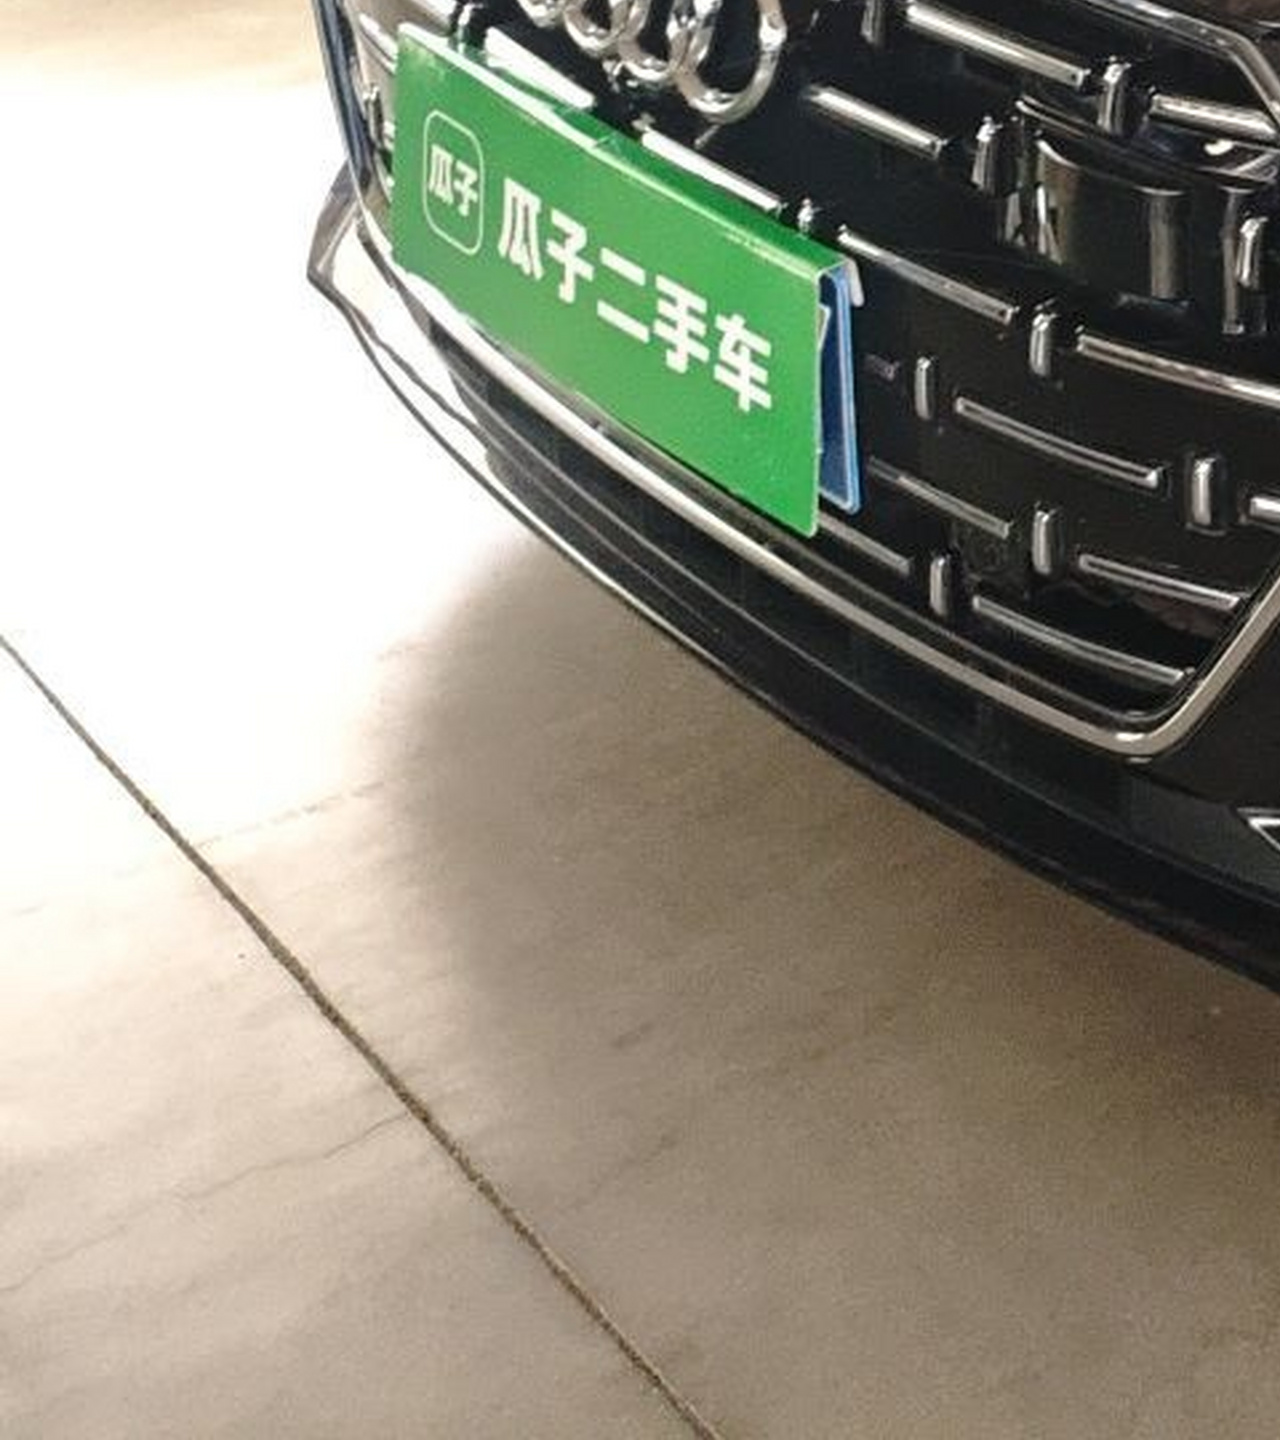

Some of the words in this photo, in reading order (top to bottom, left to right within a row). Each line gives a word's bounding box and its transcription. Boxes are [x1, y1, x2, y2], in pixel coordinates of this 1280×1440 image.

[428, 145, 478, 217] 瓜子
[498, 177, 772, 413] 瓜子二手车
